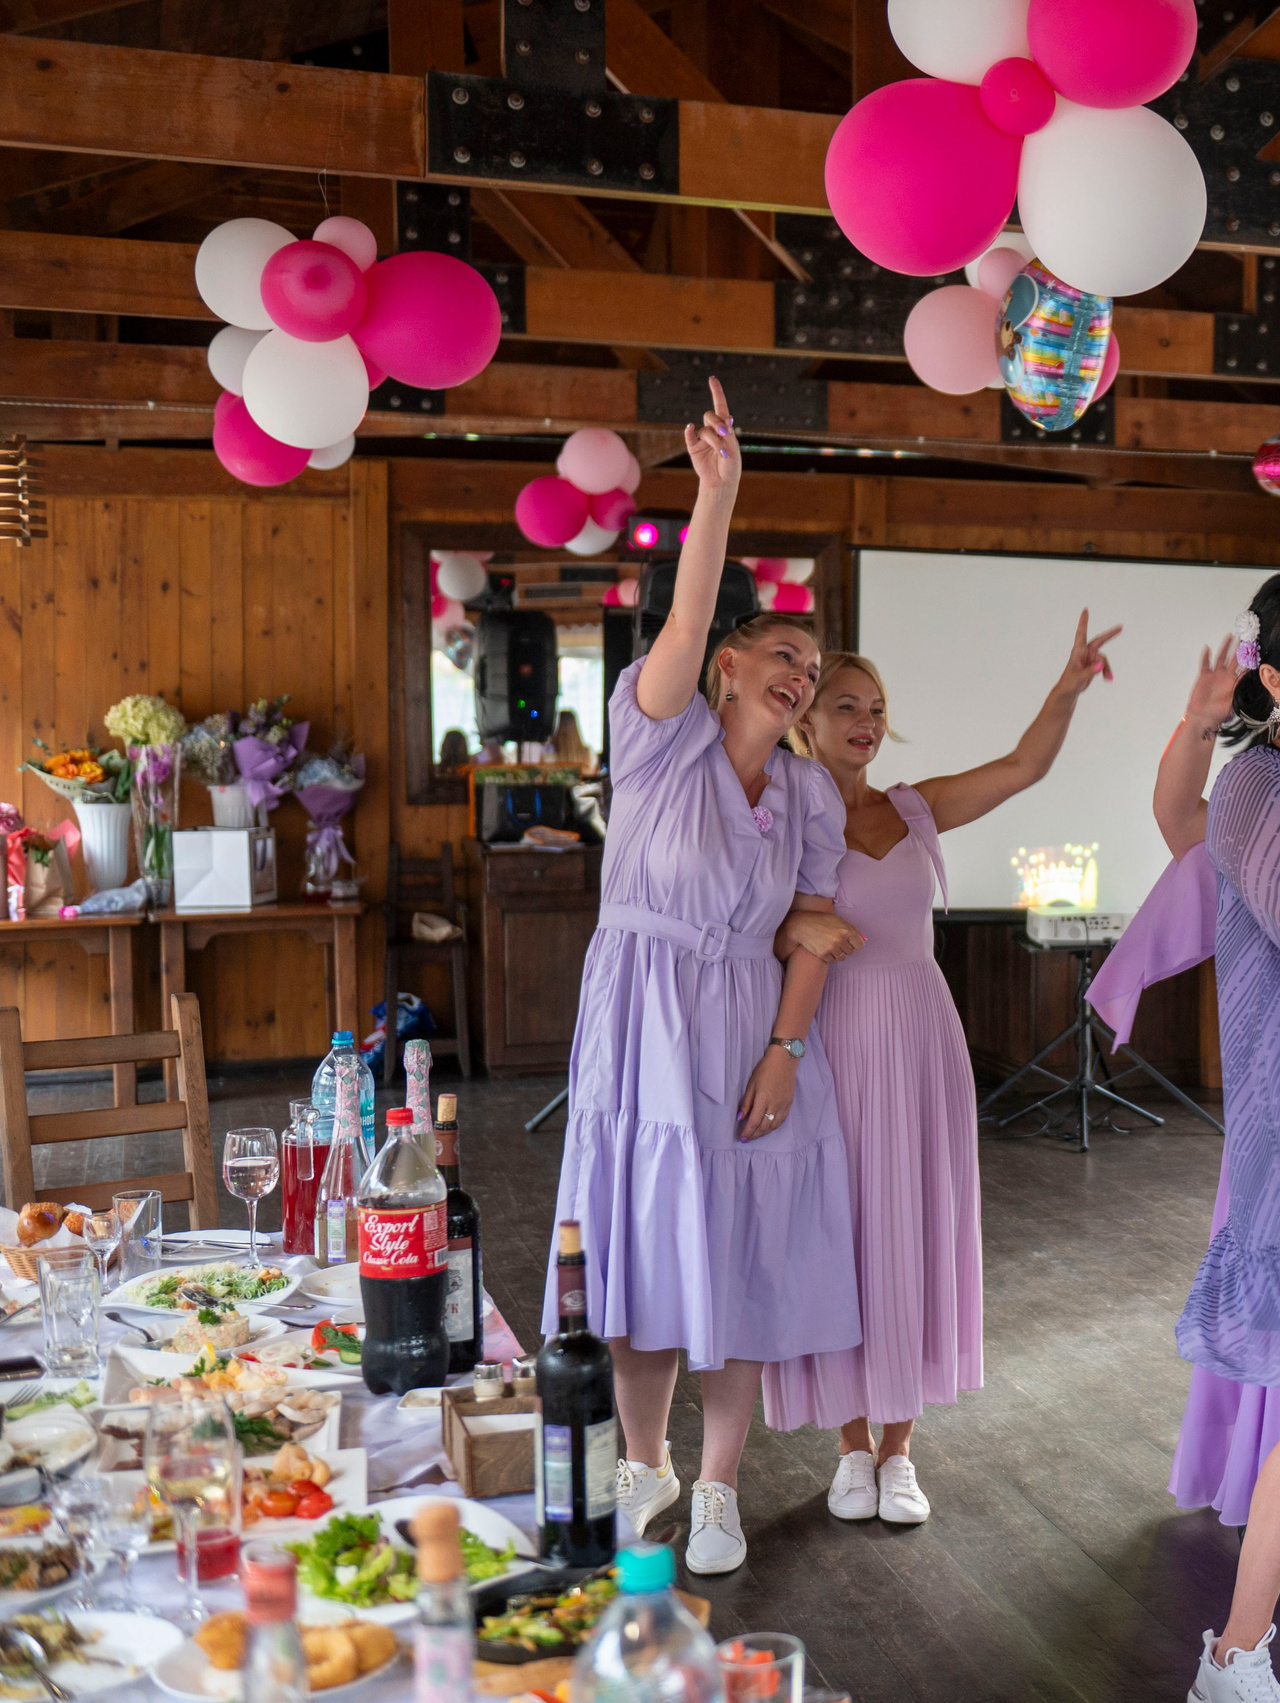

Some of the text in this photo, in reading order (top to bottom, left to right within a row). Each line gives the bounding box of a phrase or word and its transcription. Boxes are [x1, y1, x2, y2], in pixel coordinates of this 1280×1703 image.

[364, 1214, 419, 1241] Export
[369, 1231, 409, 1255] Style
[391, 1250, 419, 1265] Cola
